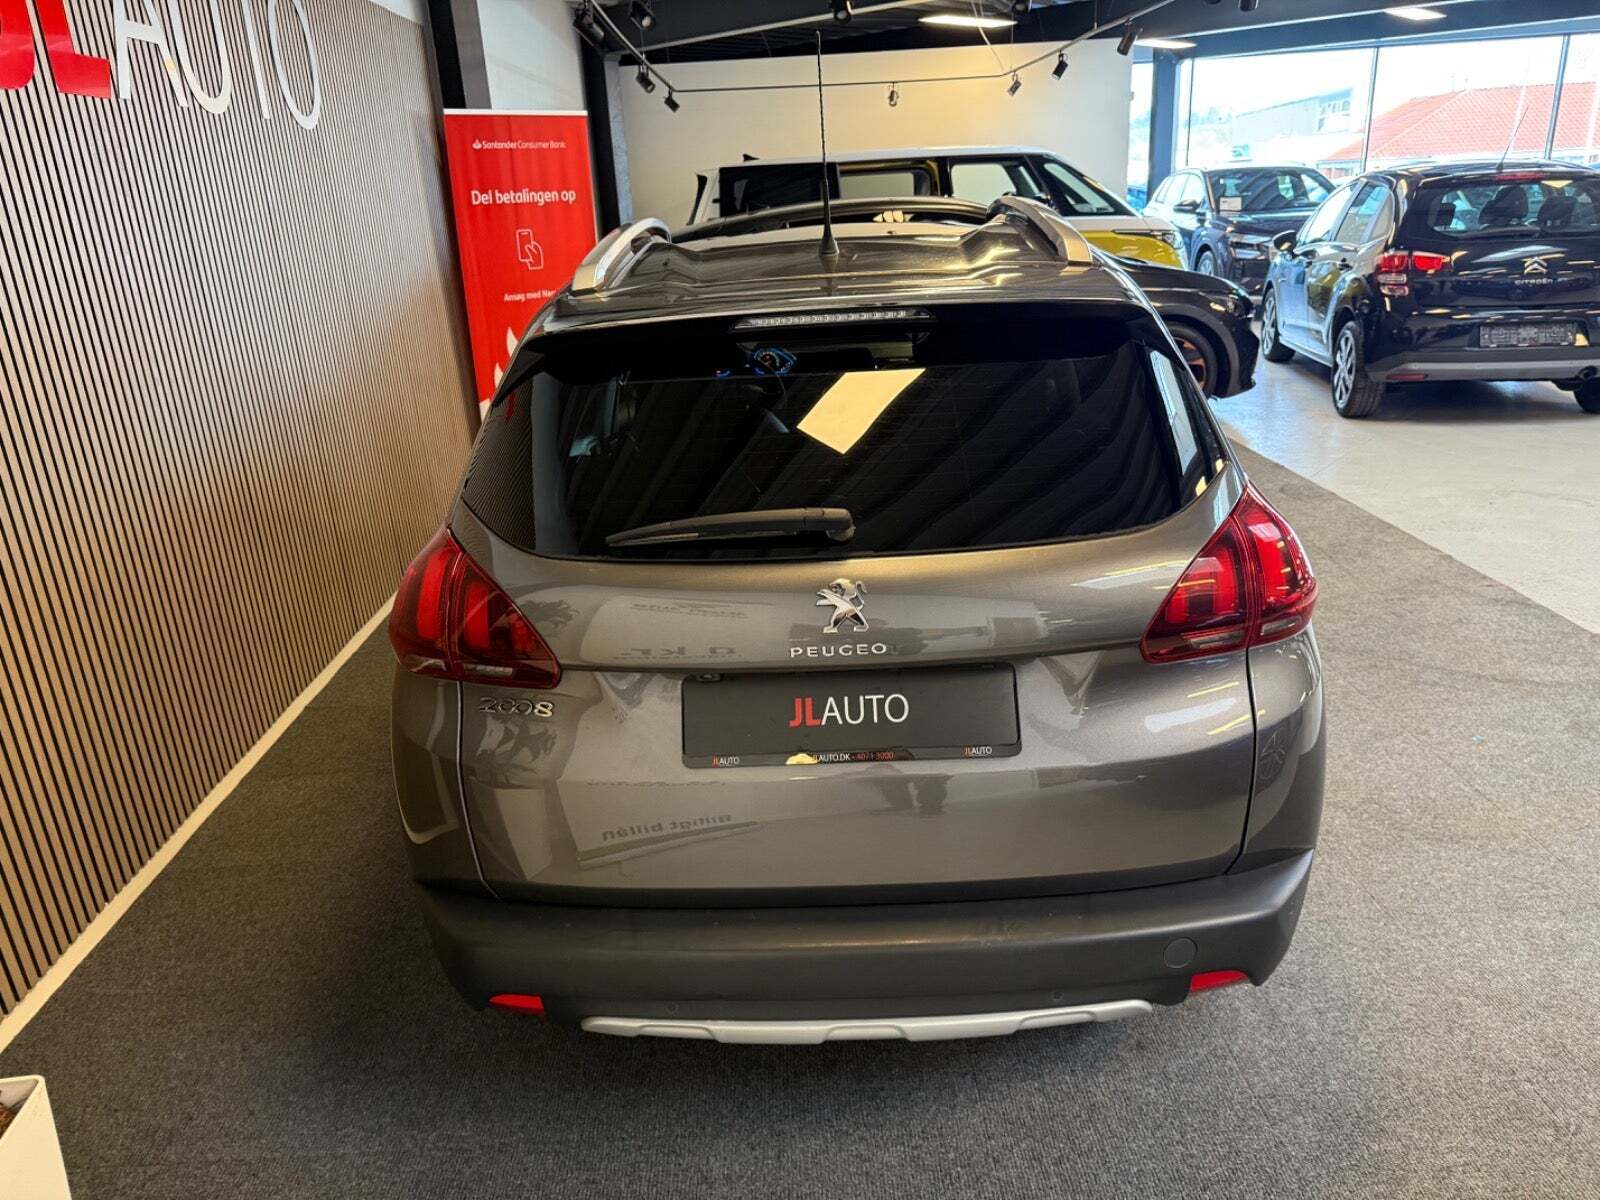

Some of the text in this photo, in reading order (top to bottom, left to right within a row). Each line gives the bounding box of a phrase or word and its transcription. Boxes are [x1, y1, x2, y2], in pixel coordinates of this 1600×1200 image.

[471, 188, 577, 206] Del betalingen op
[790, 642, 898, 658] PEUGEO
[479, 697, 554, 718] 2008
[789, 694, 910, 728] JLAUTO
[963, 745, 993, 757] JLAUTO
[712, 755, 741, 767] JLAUTO
